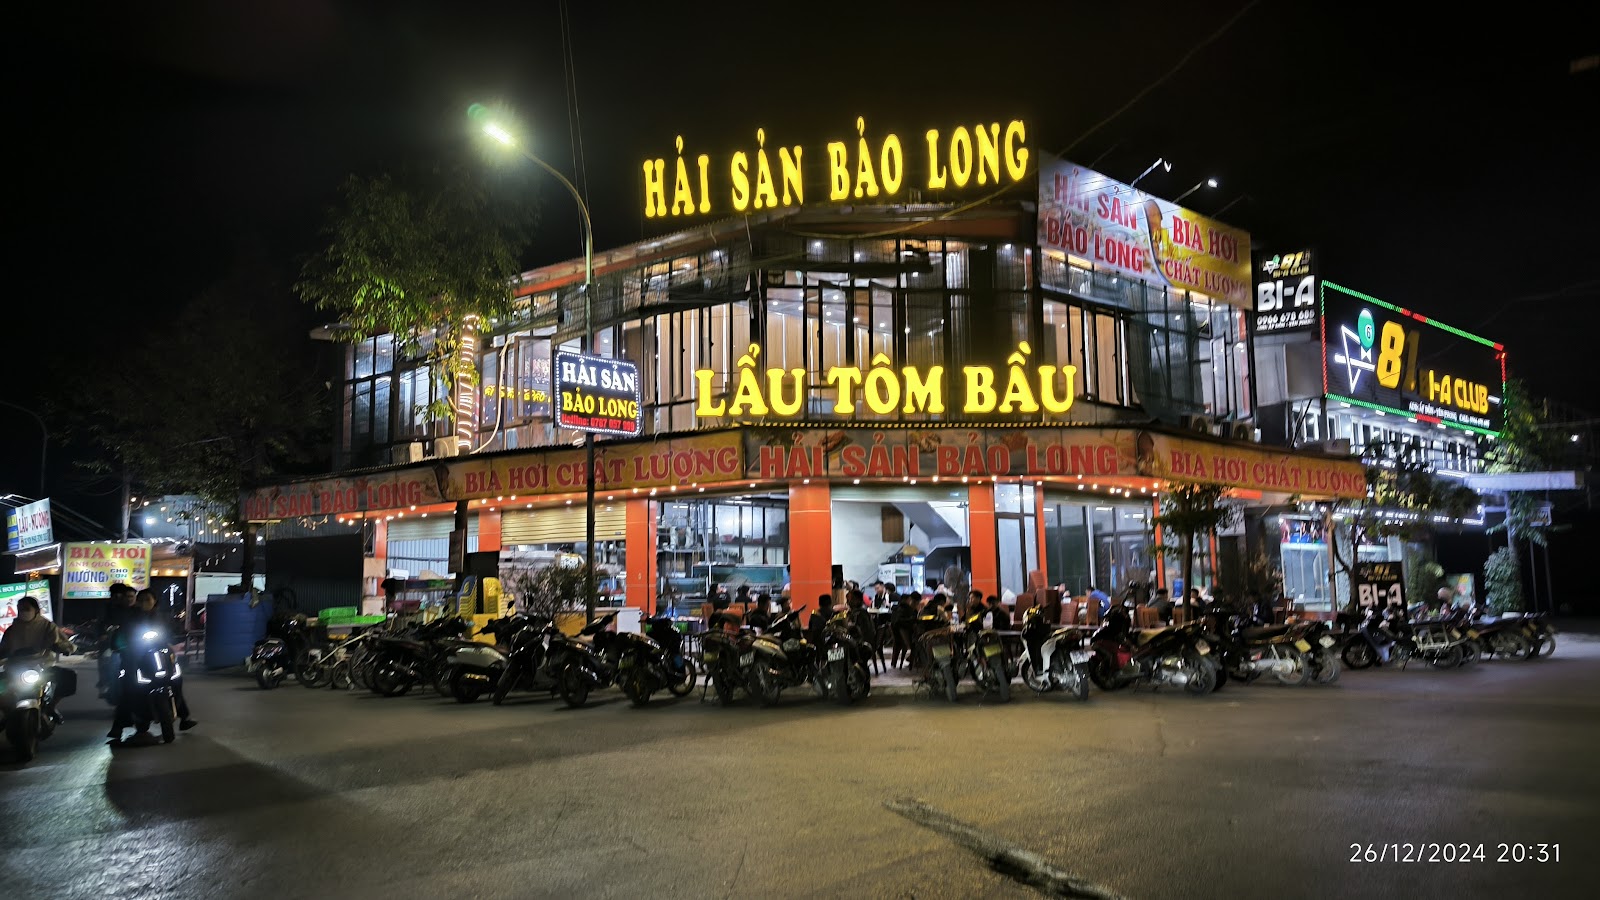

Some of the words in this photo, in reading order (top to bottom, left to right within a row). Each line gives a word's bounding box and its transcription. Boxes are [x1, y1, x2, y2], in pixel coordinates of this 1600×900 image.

[643, 135, 711, 217] HẢI
[731, 128, 803, 210] SẢN
[827, 116, 903, 200] BẢO
[926, 119, 1029, 189] LONG
[1054, 167, 1090, 213] HẢI
[1097, 185, 1138, 230] SẢN
[1047, 210, 1088, 254] BẢO
[1094, 232, 1144, 273] LONG
[1172, 215, 1204, 252] BIA
[1209, 229, 1239, 264] HƠI
[1165, 257, 1200, 286] CHẤT
[1258, 275, 1314, 312] BI-A
[562, 358, 597, 387] HẢI
[601, 364, 635, 392] SẢN
[695, 343, 806, 417] LẨU
[827, 352, 944, 415] TÔM
[963, 341, 1077, 414] BẦU
[562, 387, 595, 414] BẢO
[598, 397, 637, 418] LONG
[1454, 378, 1489, 415] CLUB
[465, 469, 502, 494] BIA
[508, 462, 550, 490] HƠI
[633, 446, 739, 485] LƯỢNG
[759, 433, 823, 478] HẢI
[842, 432, 920, 477] SẢN
[936, 431, 1010, 476] BẢO
[1026, 443, 1119, 475] LONG
[1170, 450, 1207, 480] BIA
[1213, 455, 1248, 483] HƠI
[1253, 457, 1301, 489] CHẤT
[276, 484, 312, 517] SẢN
[320, 480, 358, 514] BẢO
[367, 480, 421, 509] LONG
[70, 547, 105, 559] BIA
[112, 546, 146, 559] HƠI
[67, 568, 106, 583] NƯỚNG
[1358, 583, 1402, 607] BI-A
